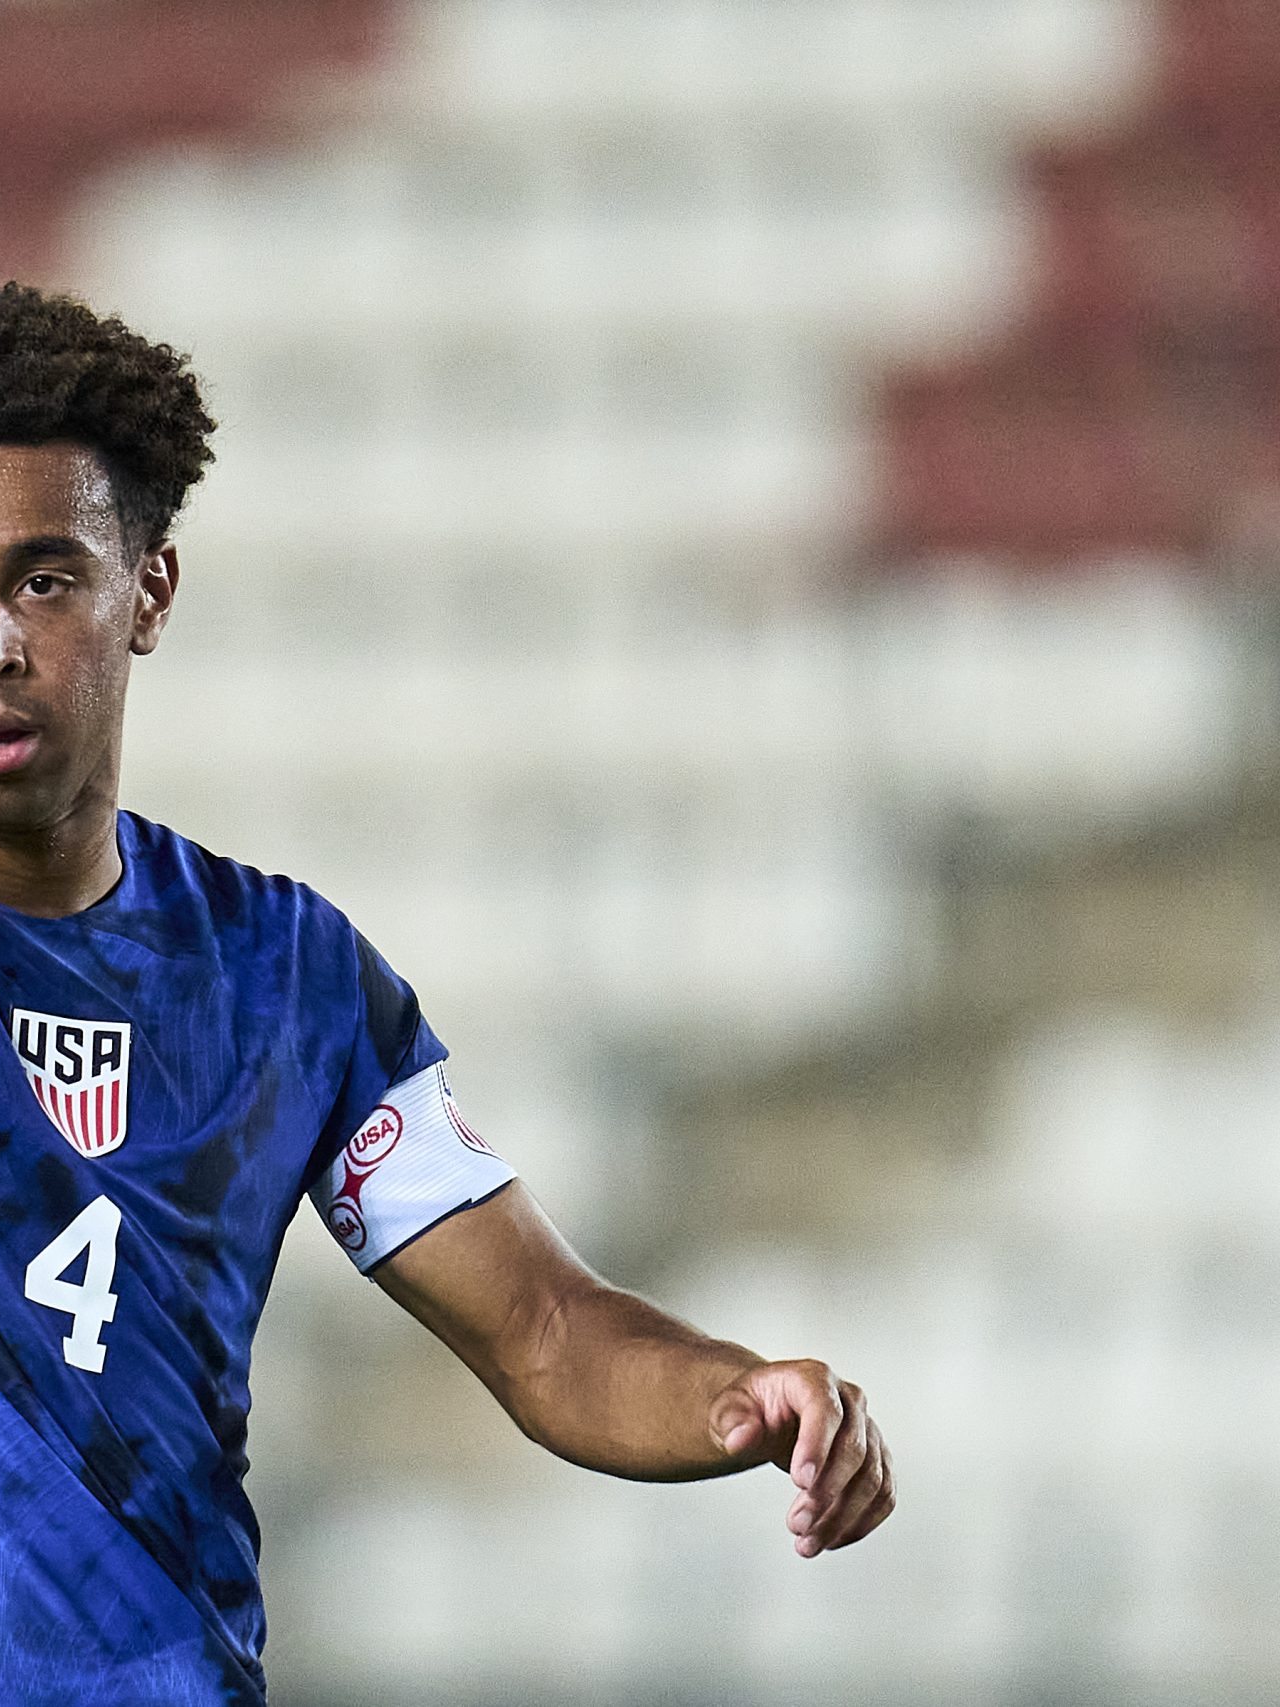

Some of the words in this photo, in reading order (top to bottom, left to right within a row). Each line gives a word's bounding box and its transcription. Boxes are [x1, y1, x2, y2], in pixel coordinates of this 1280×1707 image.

[18, 1018, 122, 1085] USA
[353, 1118, 395, 1153] USA
[24, 1194, 122, 1374] 4
